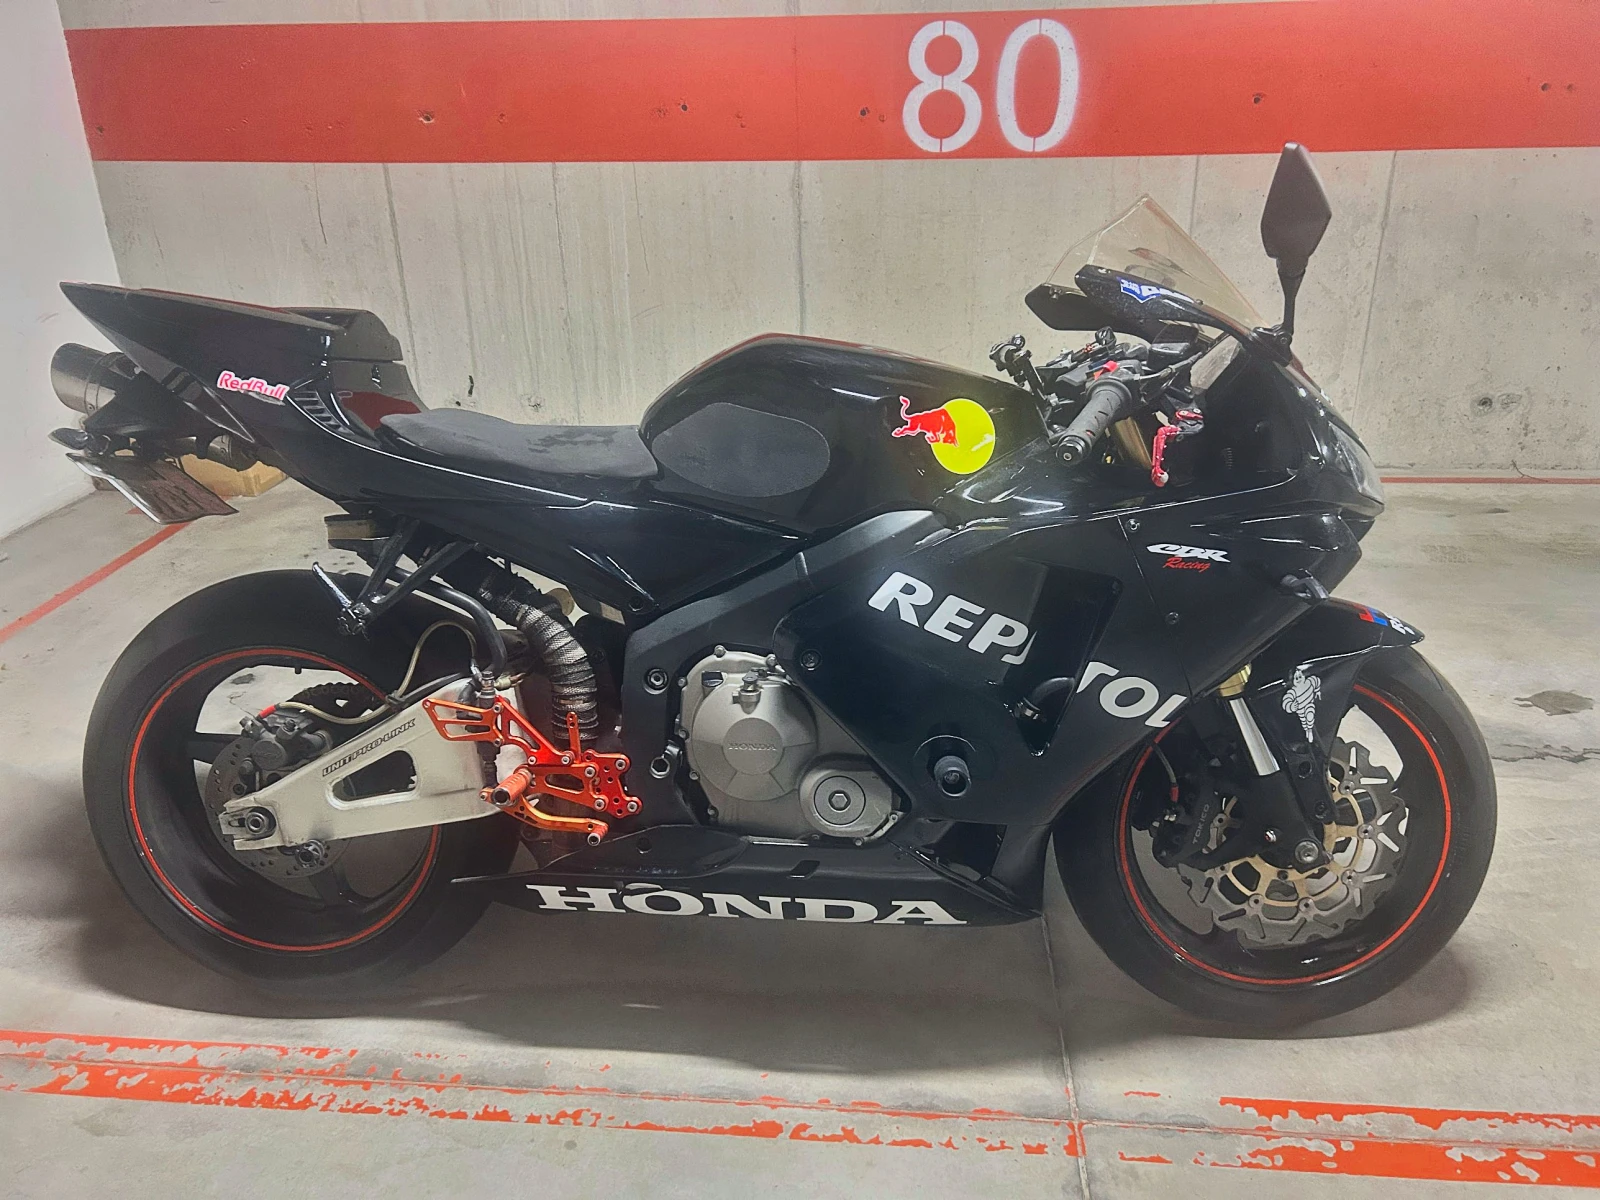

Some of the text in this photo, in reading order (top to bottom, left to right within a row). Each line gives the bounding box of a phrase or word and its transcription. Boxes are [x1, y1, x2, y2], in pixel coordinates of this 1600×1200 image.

[902, 18, 1080, 153] 80
[1146, 543, 1231, 563] CBR
[1162, 555, 1211, 573] Racing
[728, 742, 777, 751] HONDA
[1192, 803, 1210, 844] TOKICO
[526, 884, 968, 926] HONDA
